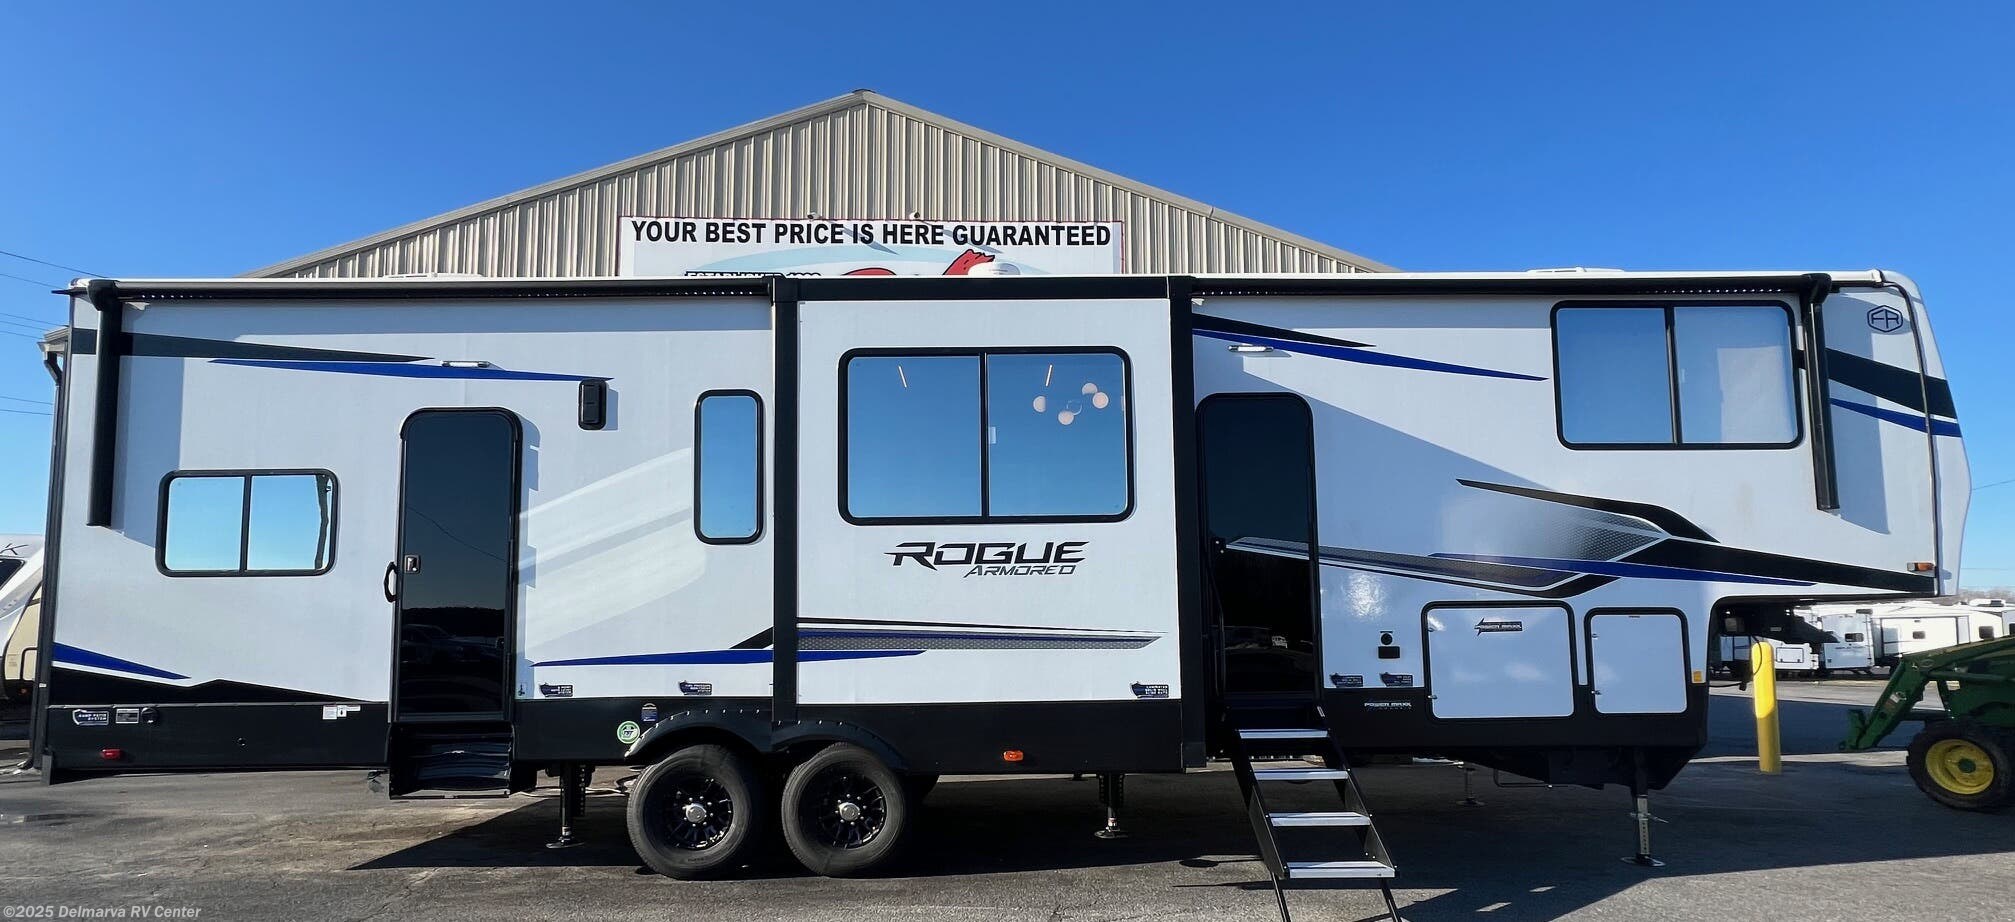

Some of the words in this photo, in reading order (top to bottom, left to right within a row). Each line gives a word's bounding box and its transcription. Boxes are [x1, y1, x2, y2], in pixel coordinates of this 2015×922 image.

[631, 220, 697, 243] YOUR
[705, 222, 766, 244] BEST
[774, 222, 844, 245] PRICE
[852, 223, 874, 245] IS
[882, 223, 944, 246] HERE
[952, 224, 1111, 246] GUARANTEED
[883, 541, 1090, 571] ROGUE
[962, 565, 1077, 578] ARMORED
